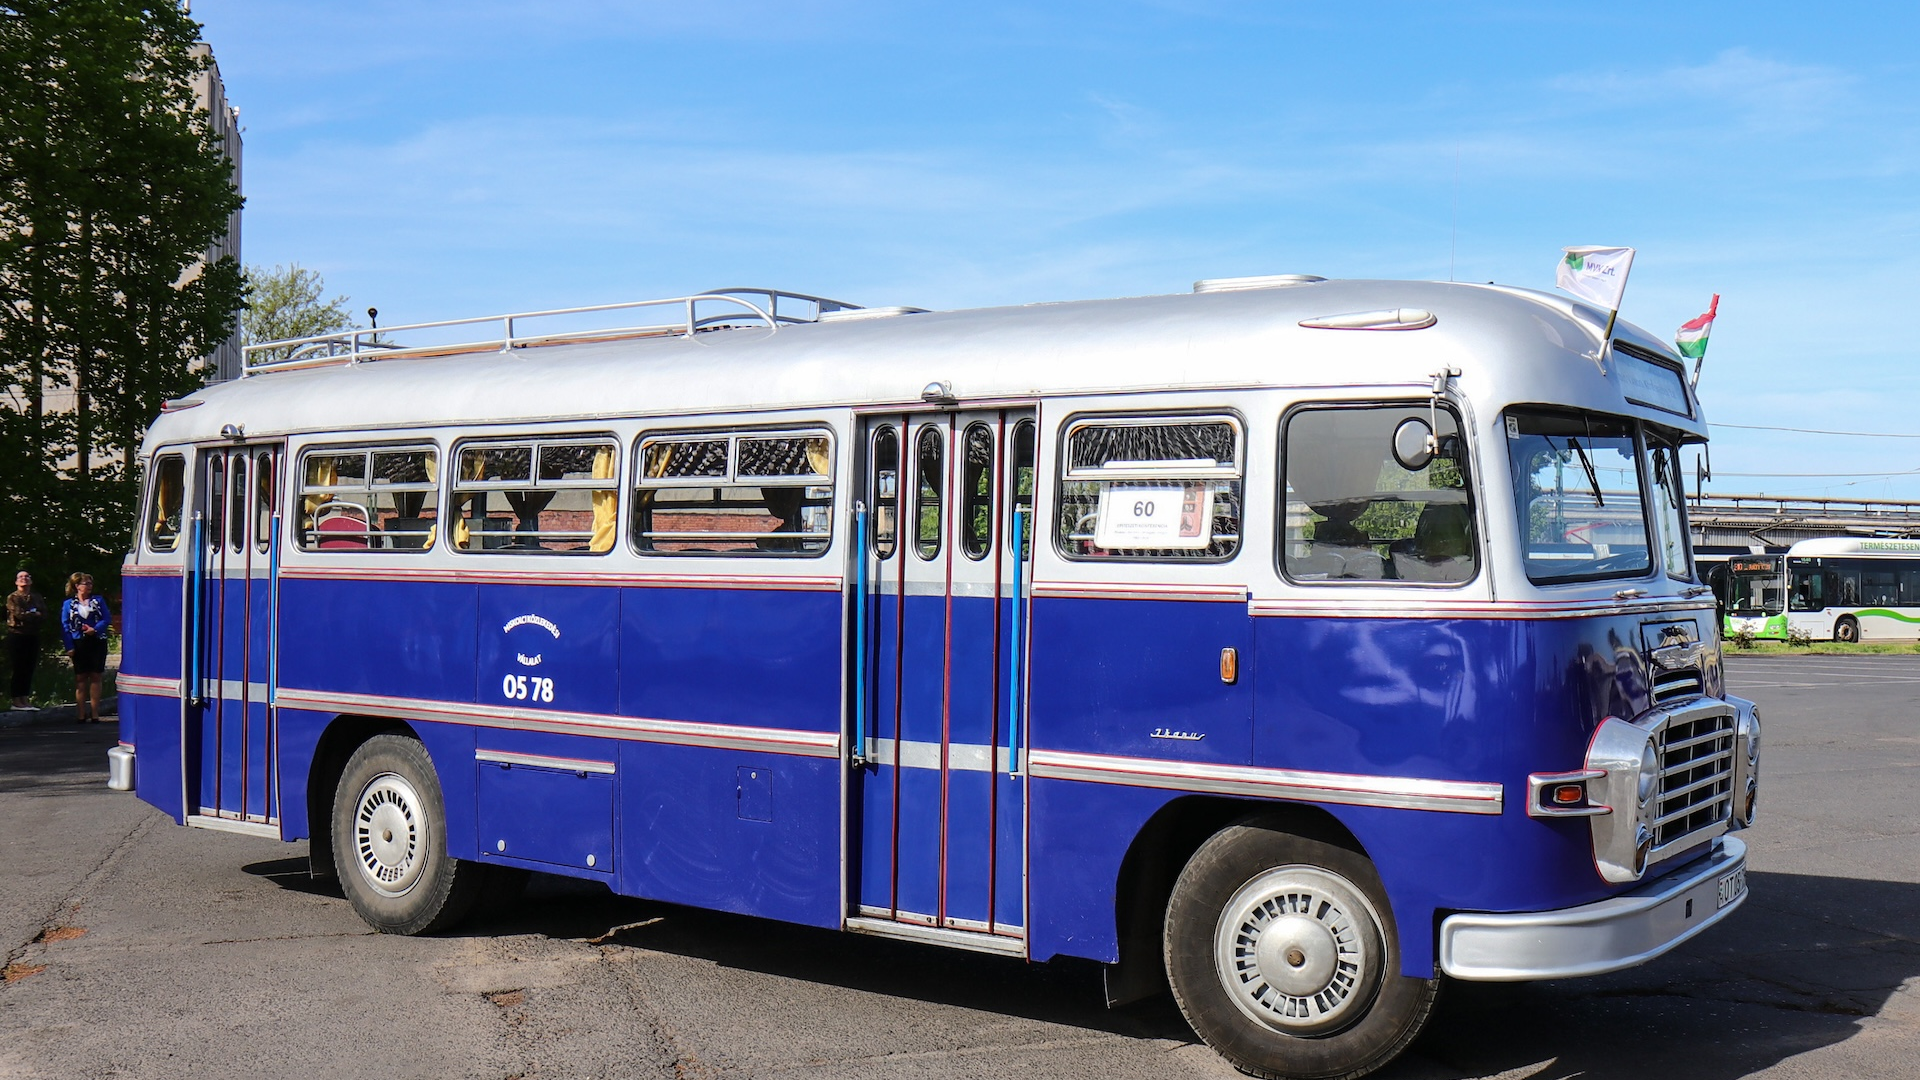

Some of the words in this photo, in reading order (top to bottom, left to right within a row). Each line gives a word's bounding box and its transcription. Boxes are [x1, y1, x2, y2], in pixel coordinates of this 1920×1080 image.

[1133, 500, 1155, 517] 60
[517, 653, 541, 666] VÁLLALAT
[503, 674, 527, 700] 05
[531, 677, 554, 703] 78
